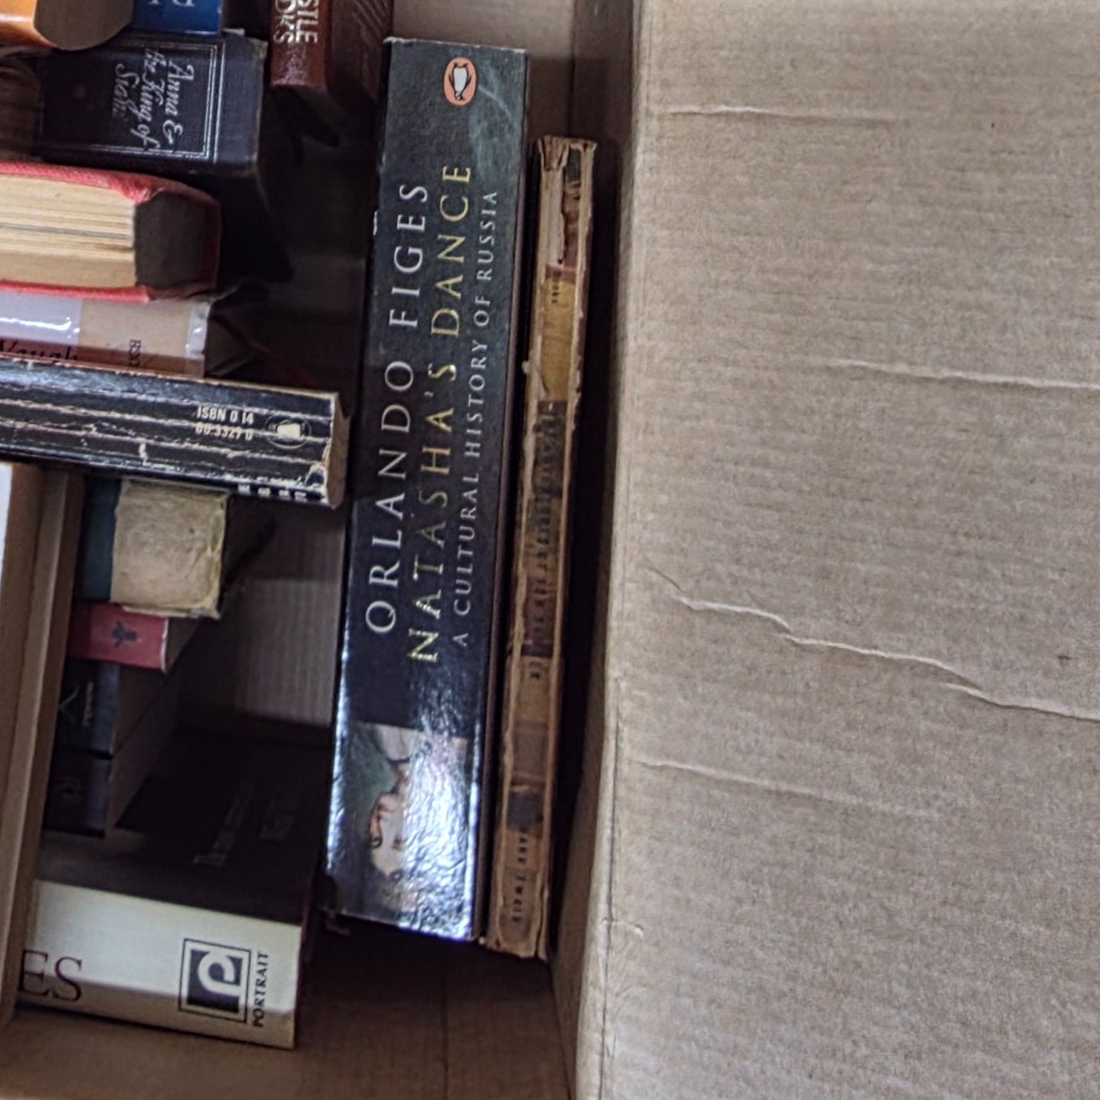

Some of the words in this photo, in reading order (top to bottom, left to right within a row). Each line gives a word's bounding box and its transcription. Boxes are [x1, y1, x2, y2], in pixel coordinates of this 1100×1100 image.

[143, 49, 168, 74] the
[165, 60, 195, 117] Anna
[128, 72, 166, 122] King
[131, 122, 161, 149] of
[162, 119, 183, 145] &
[388, 182, 429, 329] FIGES
[430, 164, 473, 338] DANCE
[476, 191, 499, 283] RUSSIA
[473, 295, 492, 328] OF
[196, 406, 227, 422] ISBN
[229, 410, 238, 424] 0
[463, 341, 489, 459] HISTORY
[364, 359, 415, 635] ORLANDO
[406, 363, 457, 664] NATASHA'S
[453, 471, 481, 617] CULTURAL
[452, 631, 469, 647] A
[252, 950, 271, 1029] PORTRAIT
